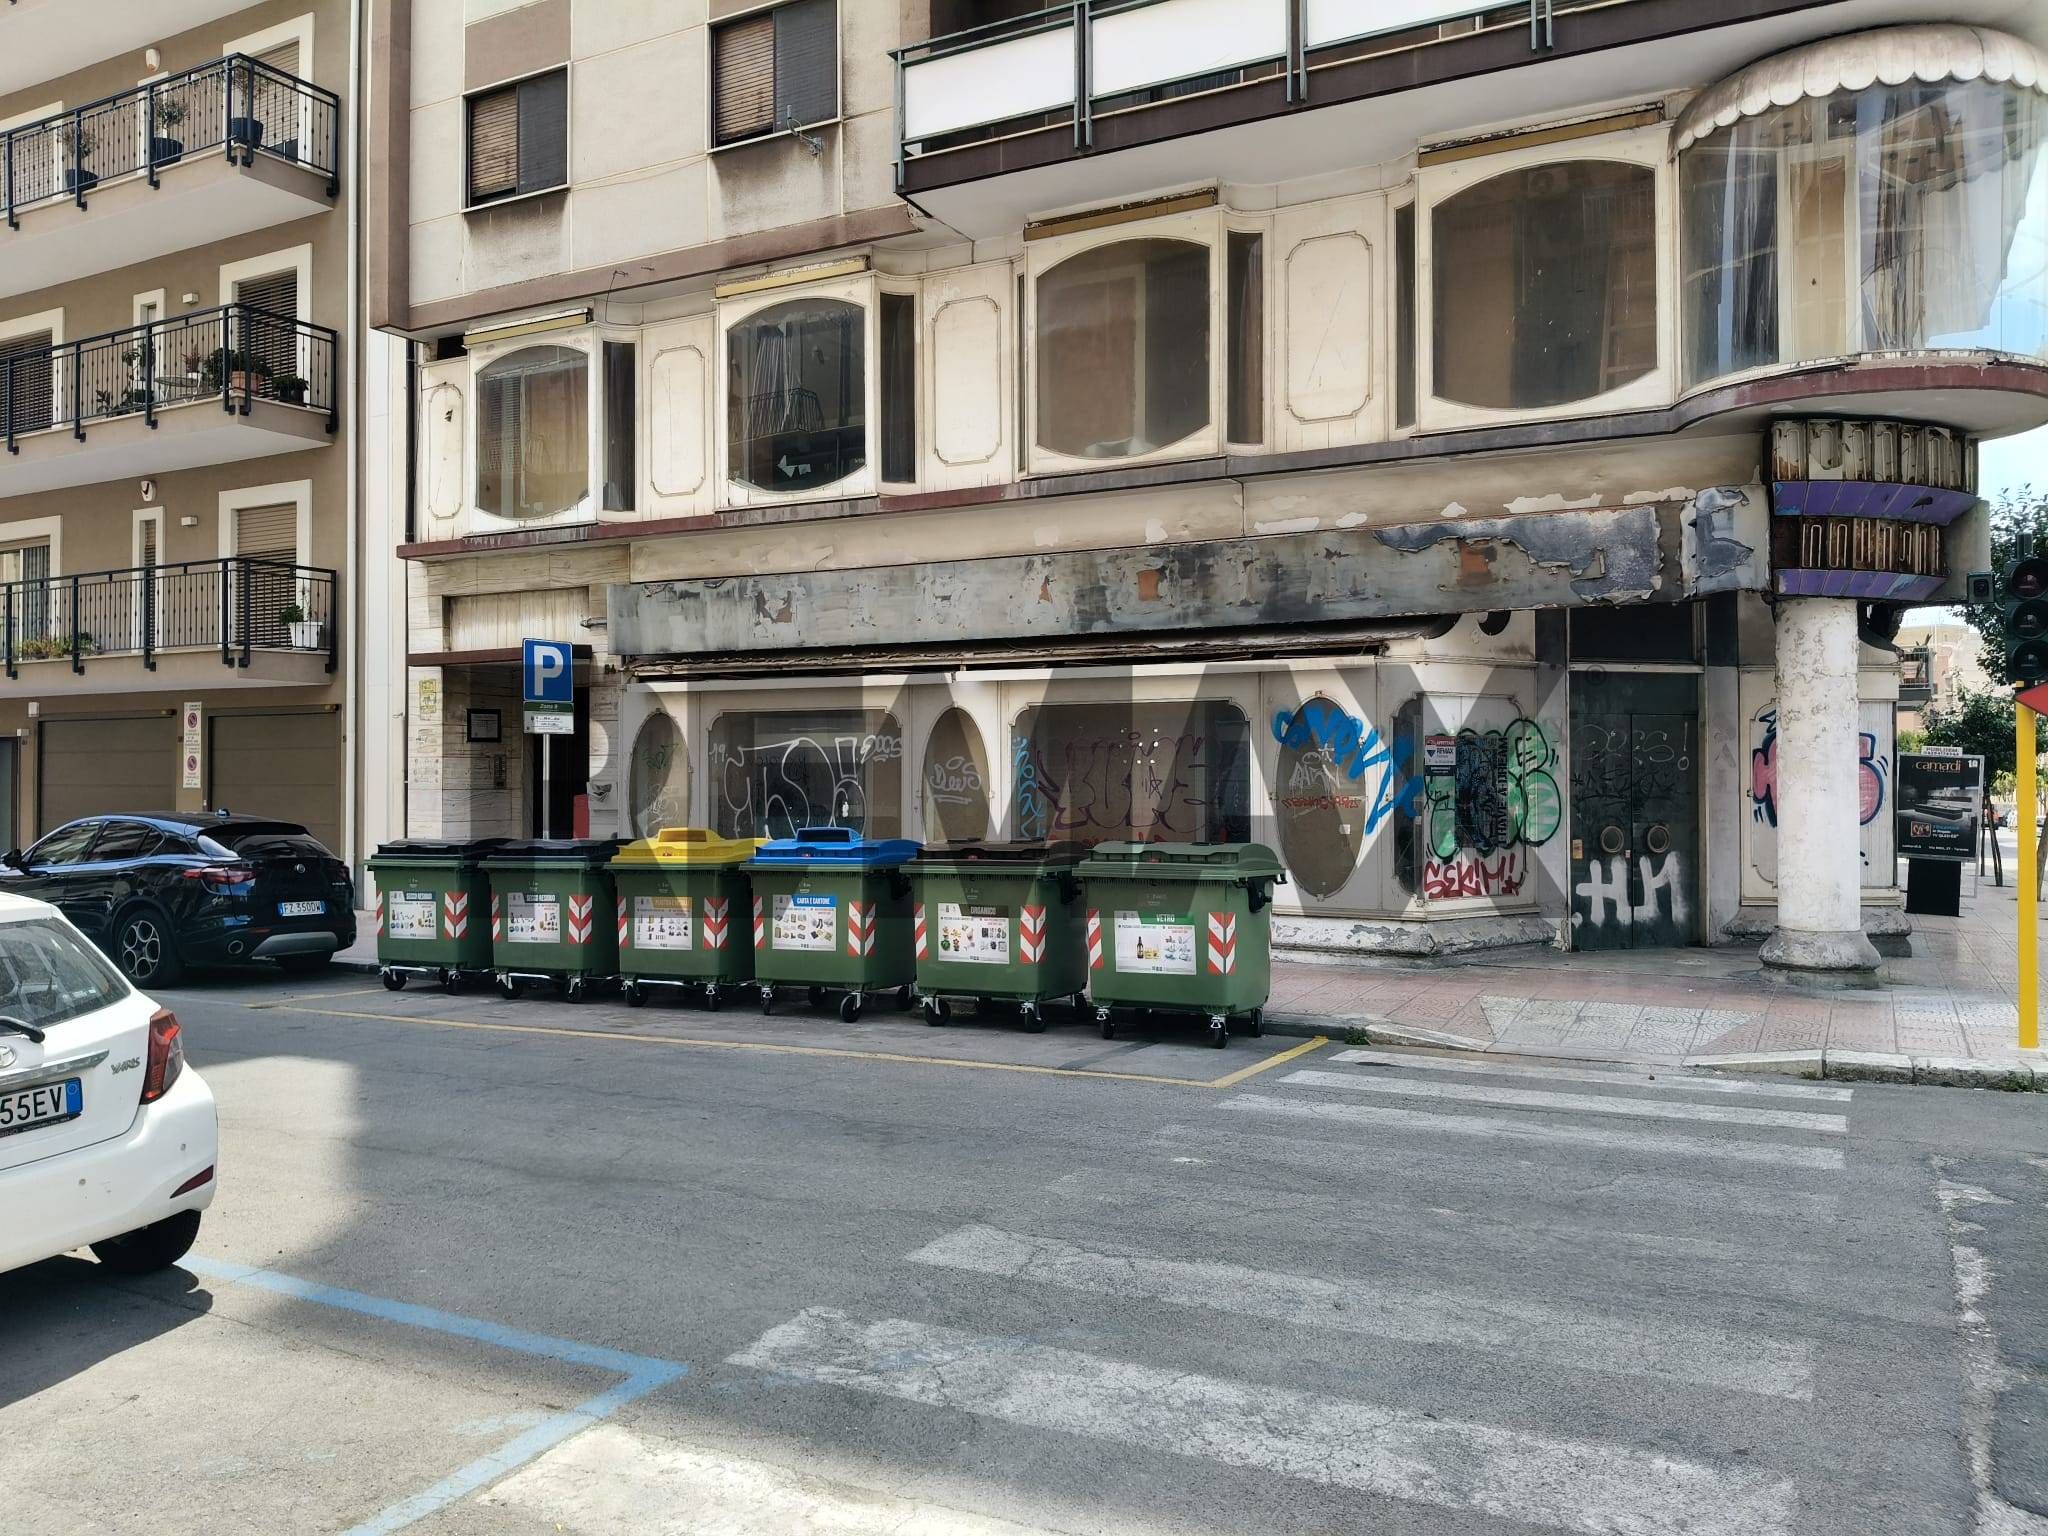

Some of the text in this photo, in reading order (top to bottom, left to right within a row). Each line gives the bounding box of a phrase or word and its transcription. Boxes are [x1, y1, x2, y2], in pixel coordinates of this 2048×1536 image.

[533, 645, 564, 697] P
[1498, 737, 1507, 784] DREAM
[1915, 760, 1961, 771] camardi
[1156, 913, 1175, 922] VETRO
[110, 1056, 141, 1075] YARIS
